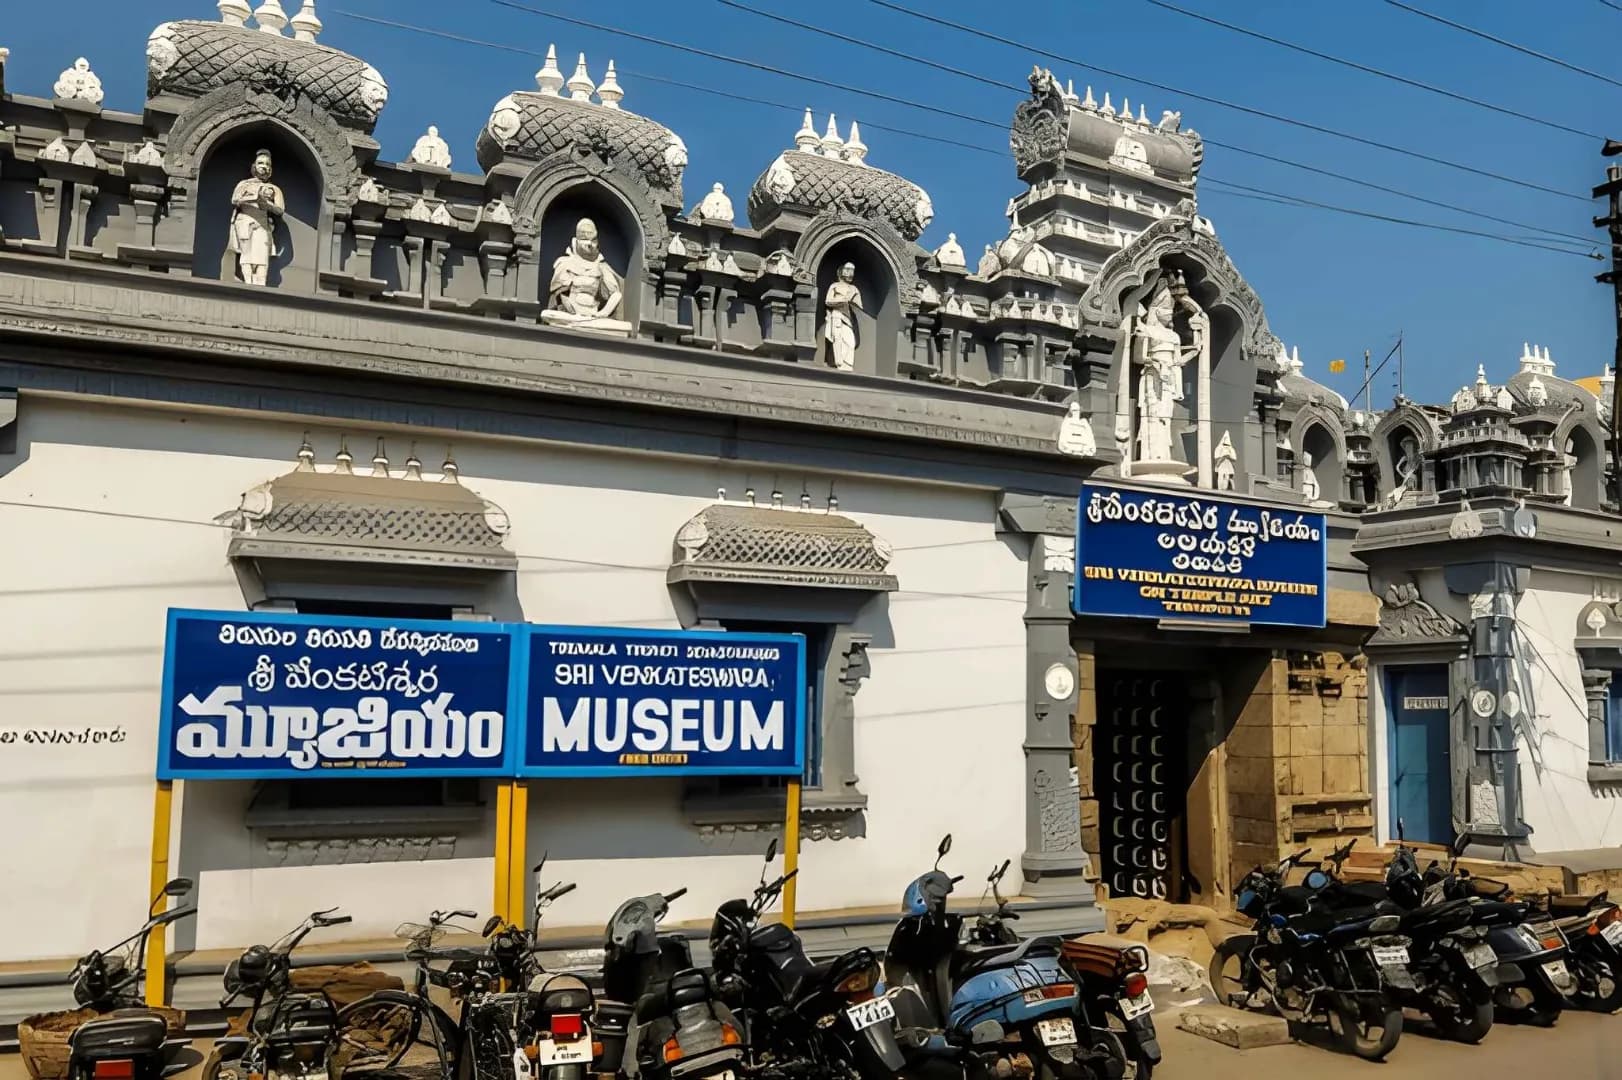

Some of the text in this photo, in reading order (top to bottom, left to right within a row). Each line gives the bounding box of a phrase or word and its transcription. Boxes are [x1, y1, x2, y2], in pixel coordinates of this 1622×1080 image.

[554, 663, 595, 685] SRI
[175, 685, 504, 769] మ్యూజియం
[542, 696, 785, 753] MUSEUM
